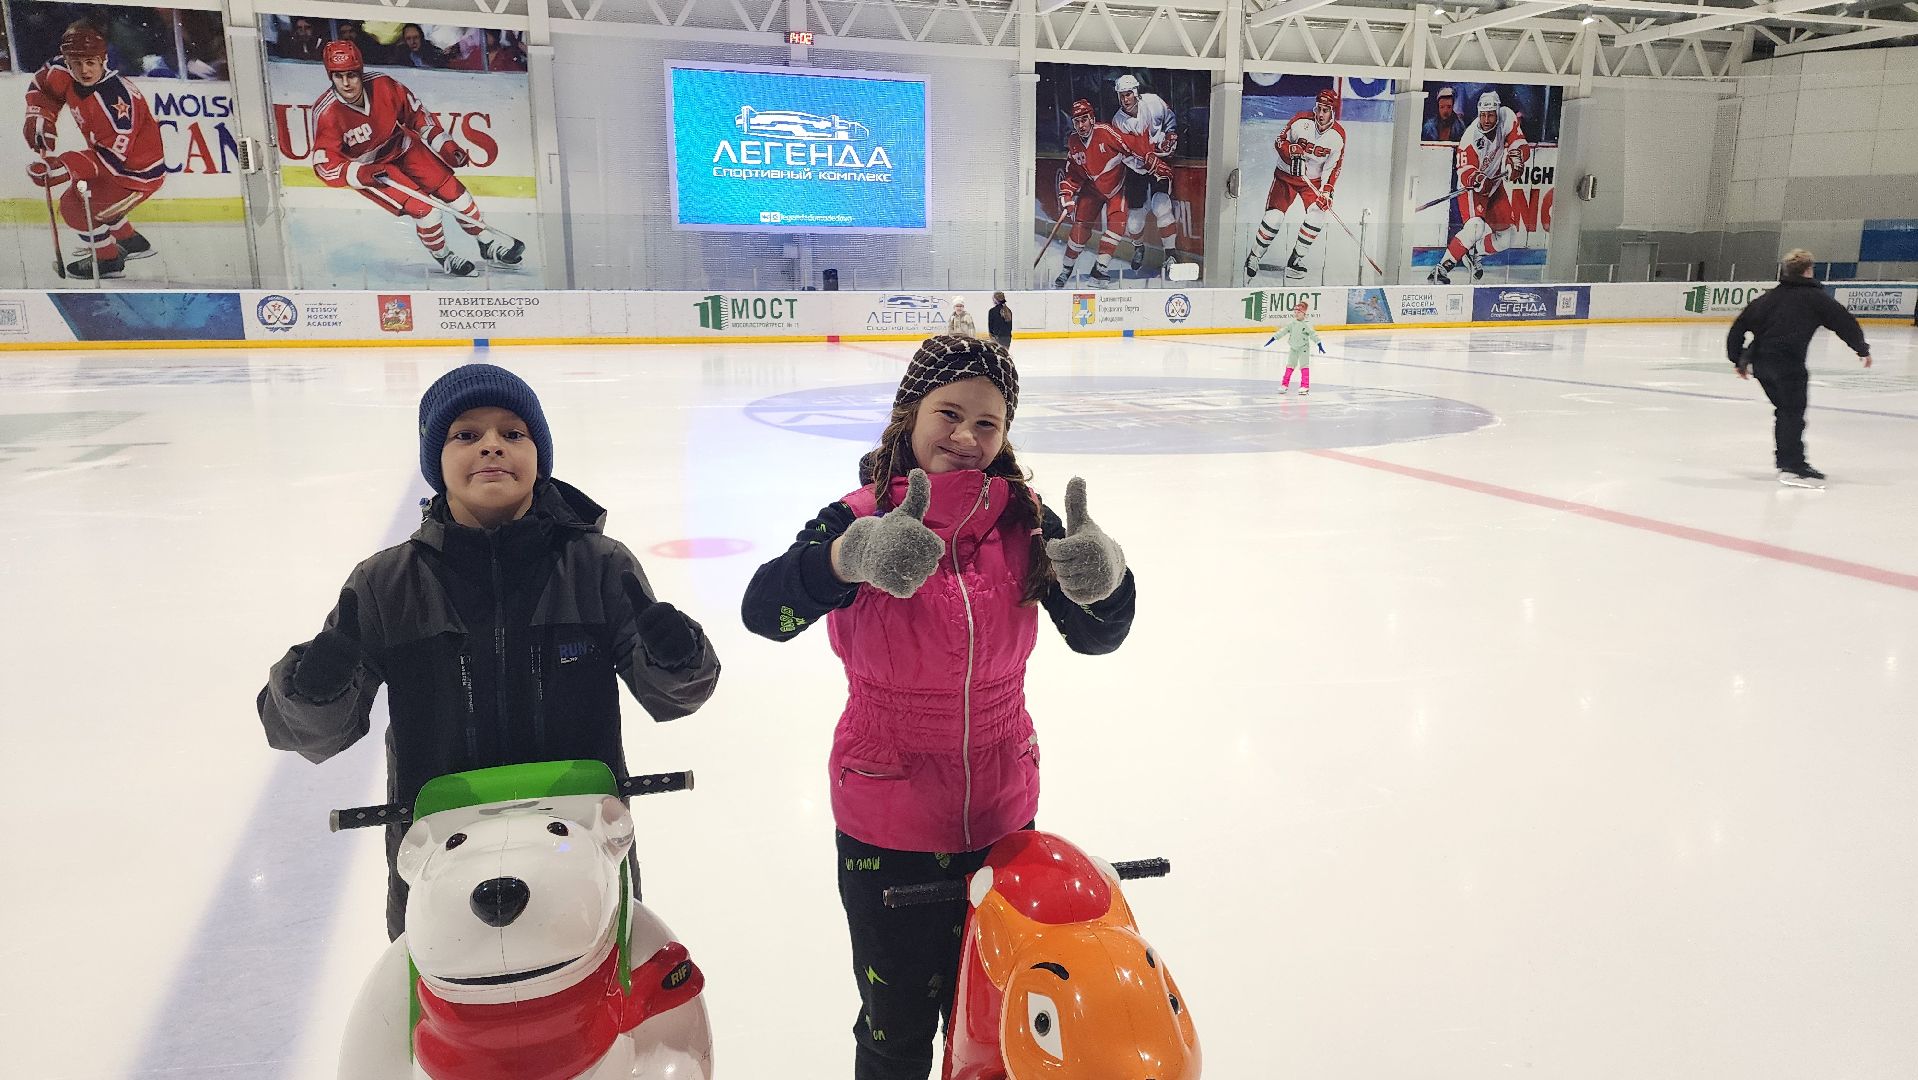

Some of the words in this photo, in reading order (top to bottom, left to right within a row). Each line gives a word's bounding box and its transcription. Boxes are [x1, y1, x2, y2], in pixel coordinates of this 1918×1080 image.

[154, 92, 233, 118] MOLS
[713, 140, 892, 169] ЛЕГЕНДА
[712, 166, 812, 181] Спортивный
[818, 171, 892, 182] комплекс
[438, 297, 540, 306] ПРАВИТЕЛЬСТВО
[1401, 293, 1433, 301] ДЕТСКИЙ
[1712, 288, 1766, 305] МОС
[439, 307, 525, 318] МОСКОВСКОЙ
[731, 297, 798, 319] МОСТ
[1490, 302, 1547, 313] ЛЕГЕНДА
[866, 311, 949, 324] ЛЕГЕНД
[440, 321, 496, 330] ОБЛАСТИ
[670, 964, 688, 986] RIF
